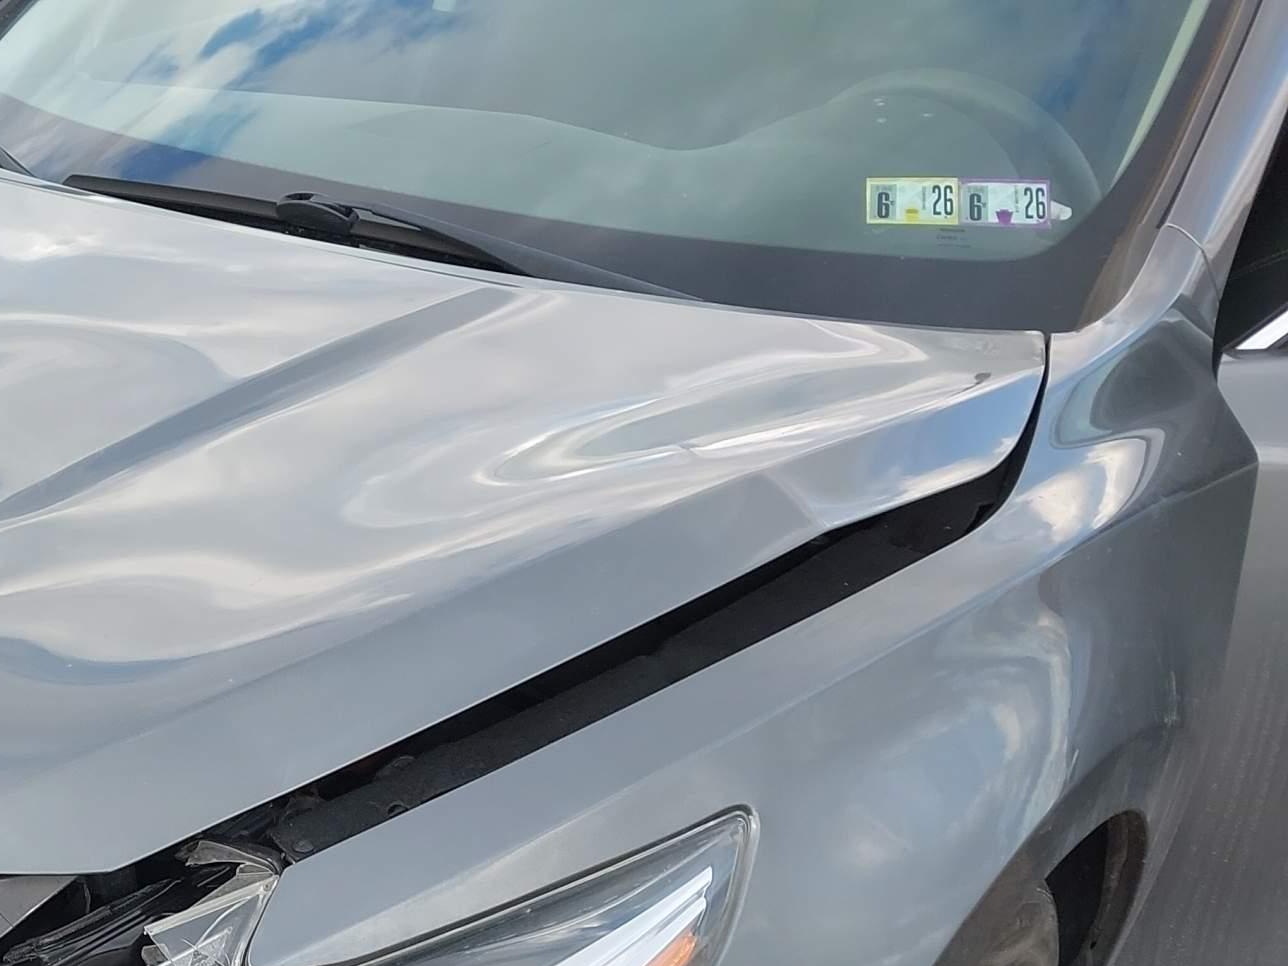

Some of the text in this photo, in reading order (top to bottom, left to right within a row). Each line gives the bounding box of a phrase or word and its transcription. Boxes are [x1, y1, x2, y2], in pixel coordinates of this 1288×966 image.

[877, 191, 890, 219] 6
[932, 184, 954, 216] 26
[969, 193, 982, 221] 6
[1023, 187, 1046, 220] 26
